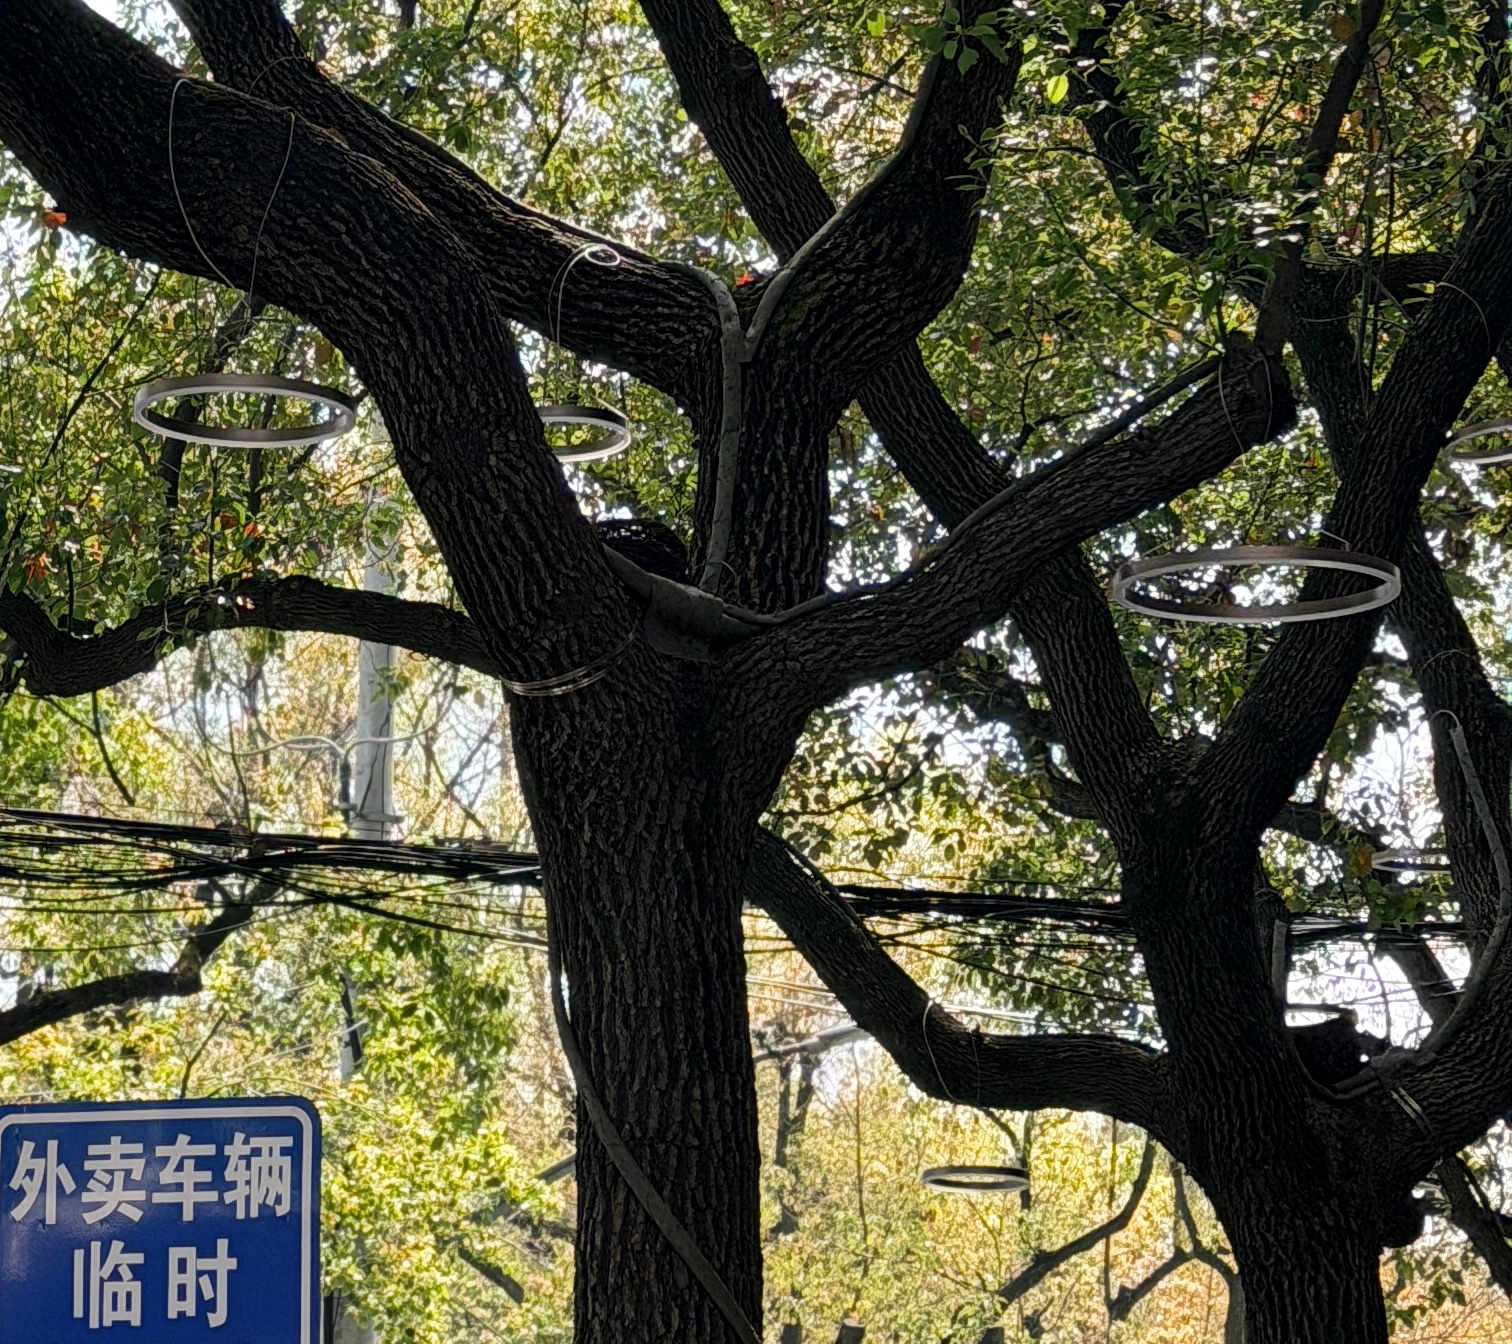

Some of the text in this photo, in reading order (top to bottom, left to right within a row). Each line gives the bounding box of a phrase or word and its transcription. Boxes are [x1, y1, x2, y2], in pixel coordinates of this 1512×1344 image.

[8, 1132, 294, 1225] 外卖车辆
[72, 1238, 238, 1329] 临时
